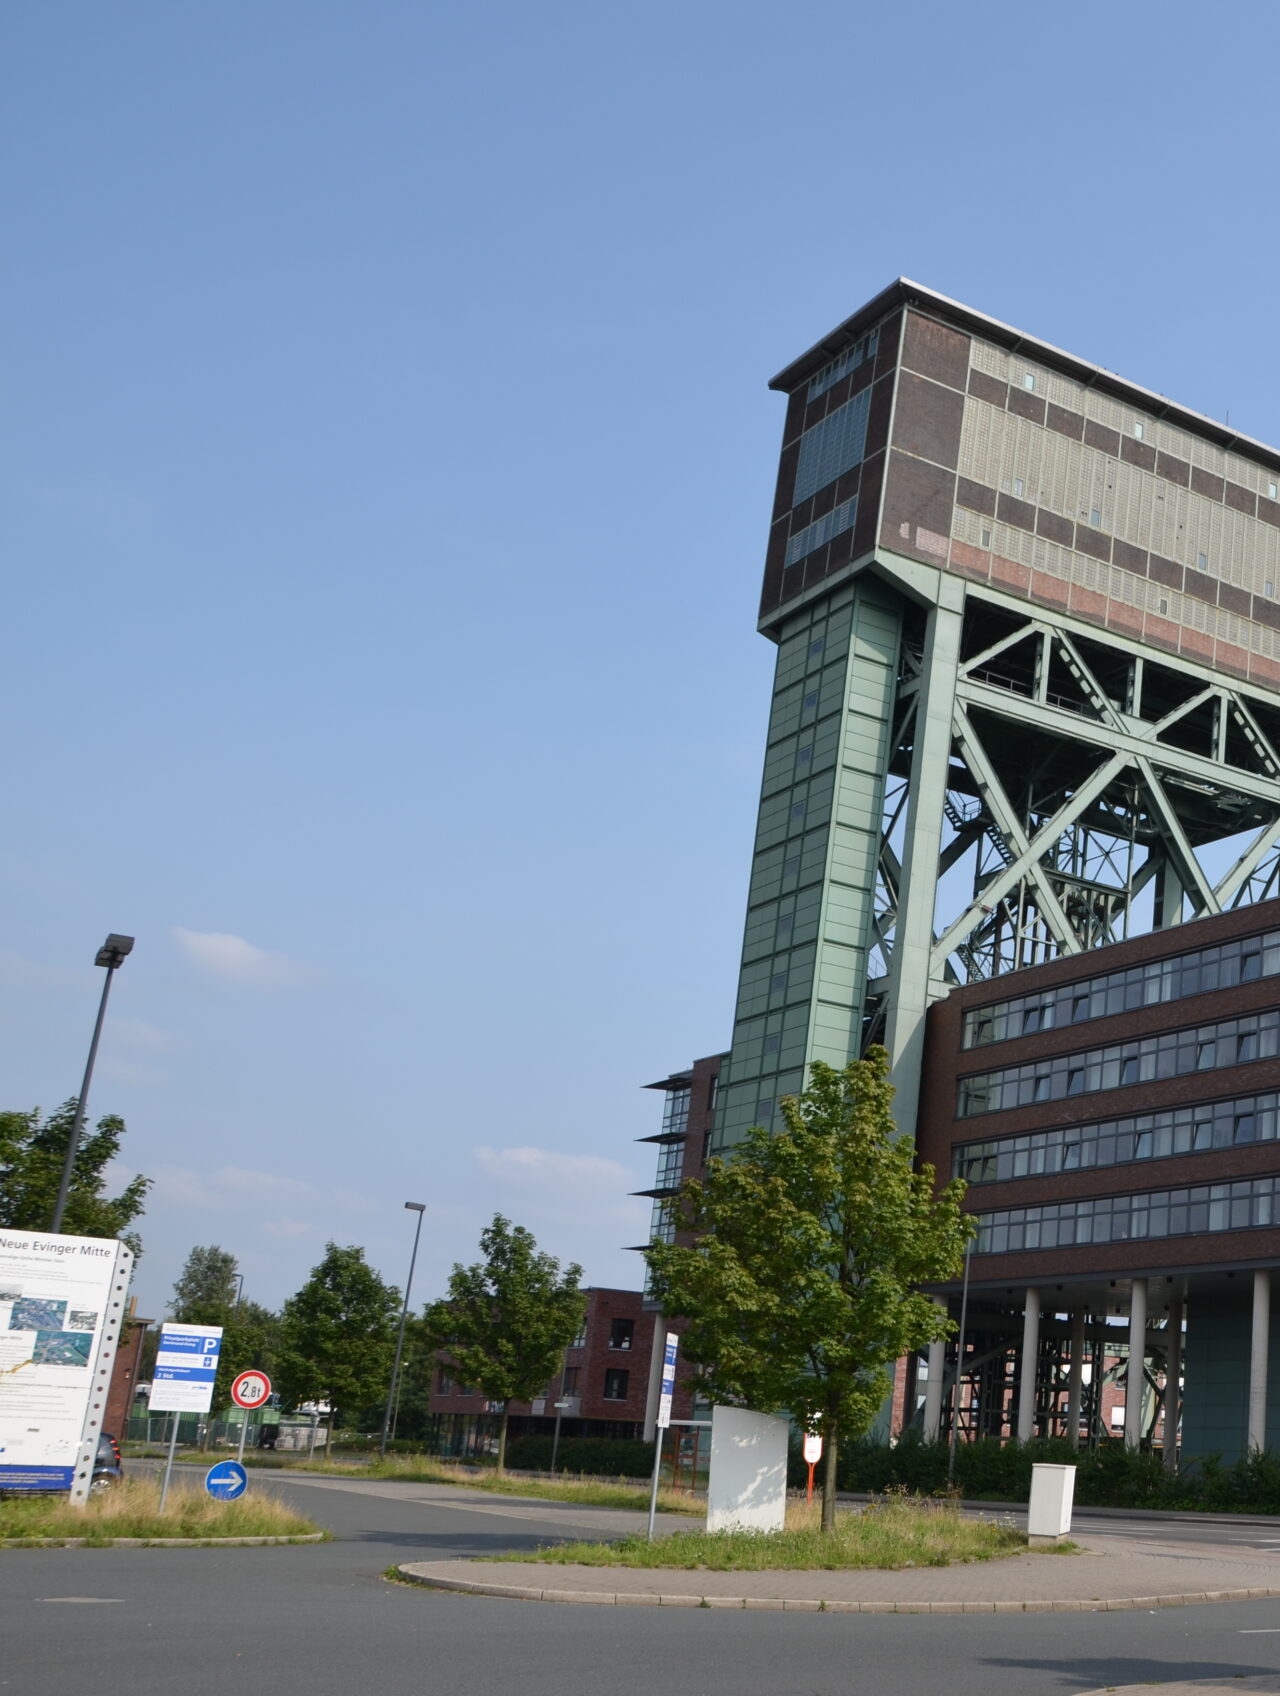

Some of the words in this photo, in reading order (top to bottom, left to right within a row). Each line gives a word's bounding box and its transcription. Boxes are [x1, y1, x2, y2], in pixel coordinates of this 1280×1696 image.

[0, 1238, 29, 1250] Neue
[33, 1241, 76, 1255] Evinger
[80, 1245, 111, 1258] Mitte
[204, 1339, 217, 1353] P
